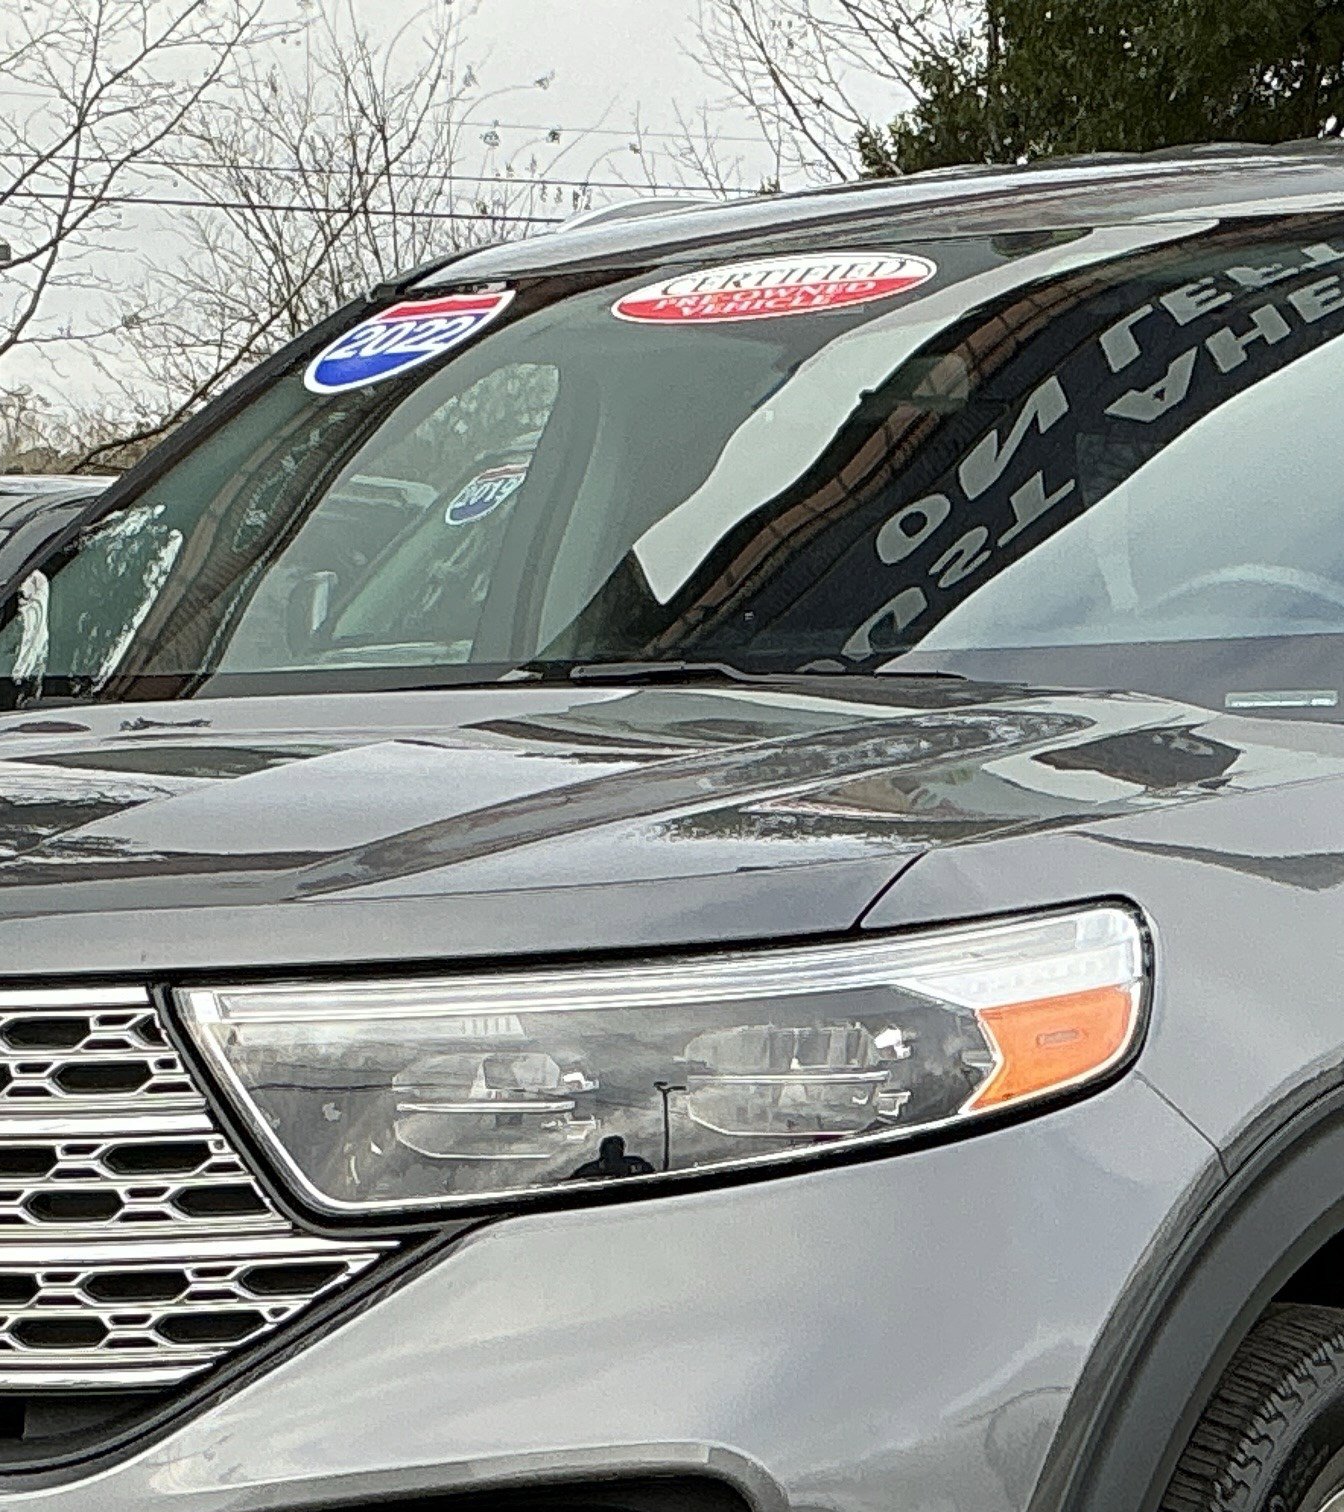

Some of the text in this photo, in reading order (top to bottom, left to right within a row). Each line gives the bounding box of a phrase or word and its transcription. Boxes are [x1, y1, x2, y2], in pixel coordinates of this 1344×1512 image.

[661, 259, 907, 296] CERTIFIED
[656, 280, 876, 310] PRE-OWNED
[680, 292, 833, 317] VEHICLE
[324, 315, 476, 361] 2022
